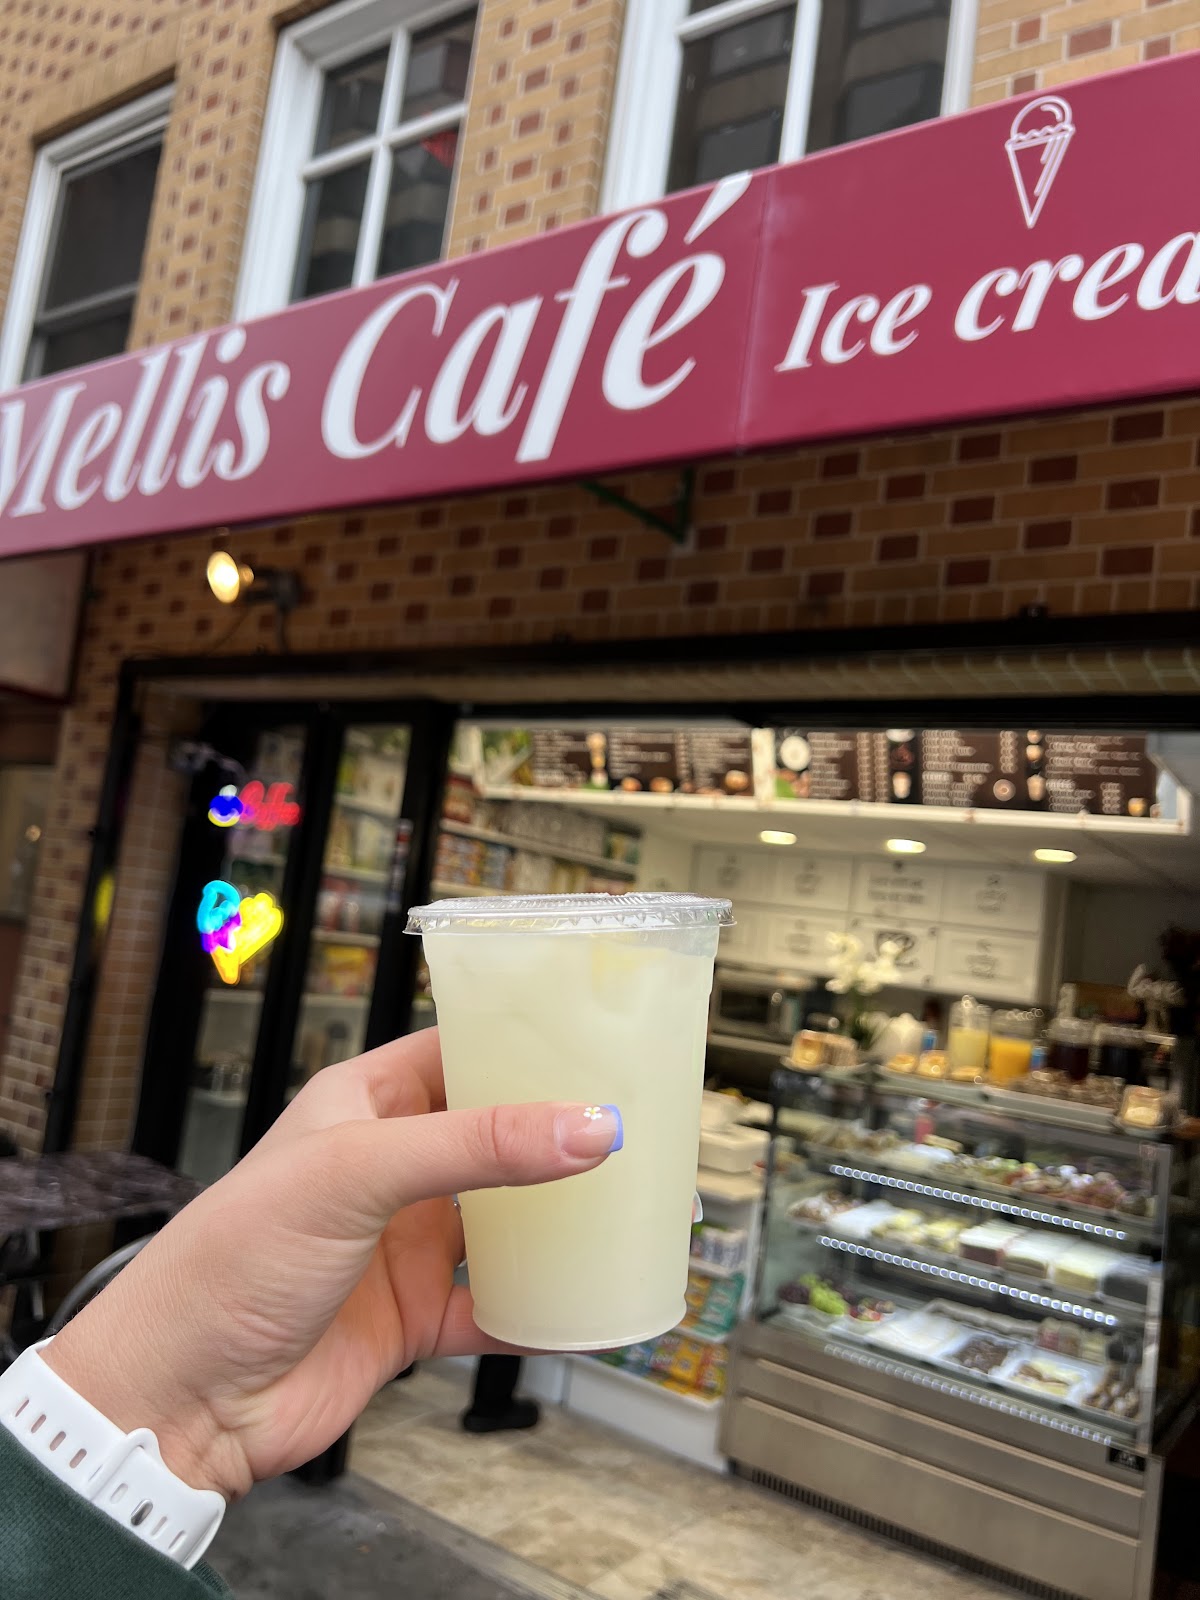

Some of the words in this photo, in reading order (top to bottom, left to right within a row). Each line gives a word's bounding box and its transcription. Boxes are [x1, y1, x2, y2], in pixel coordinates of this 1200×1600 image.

[0, 327, 291, 518] Mellis
[321, 171, 752, 463] Café
[774, 281, 932, 372] Ice
[954, 231, 1200, 343] crea
